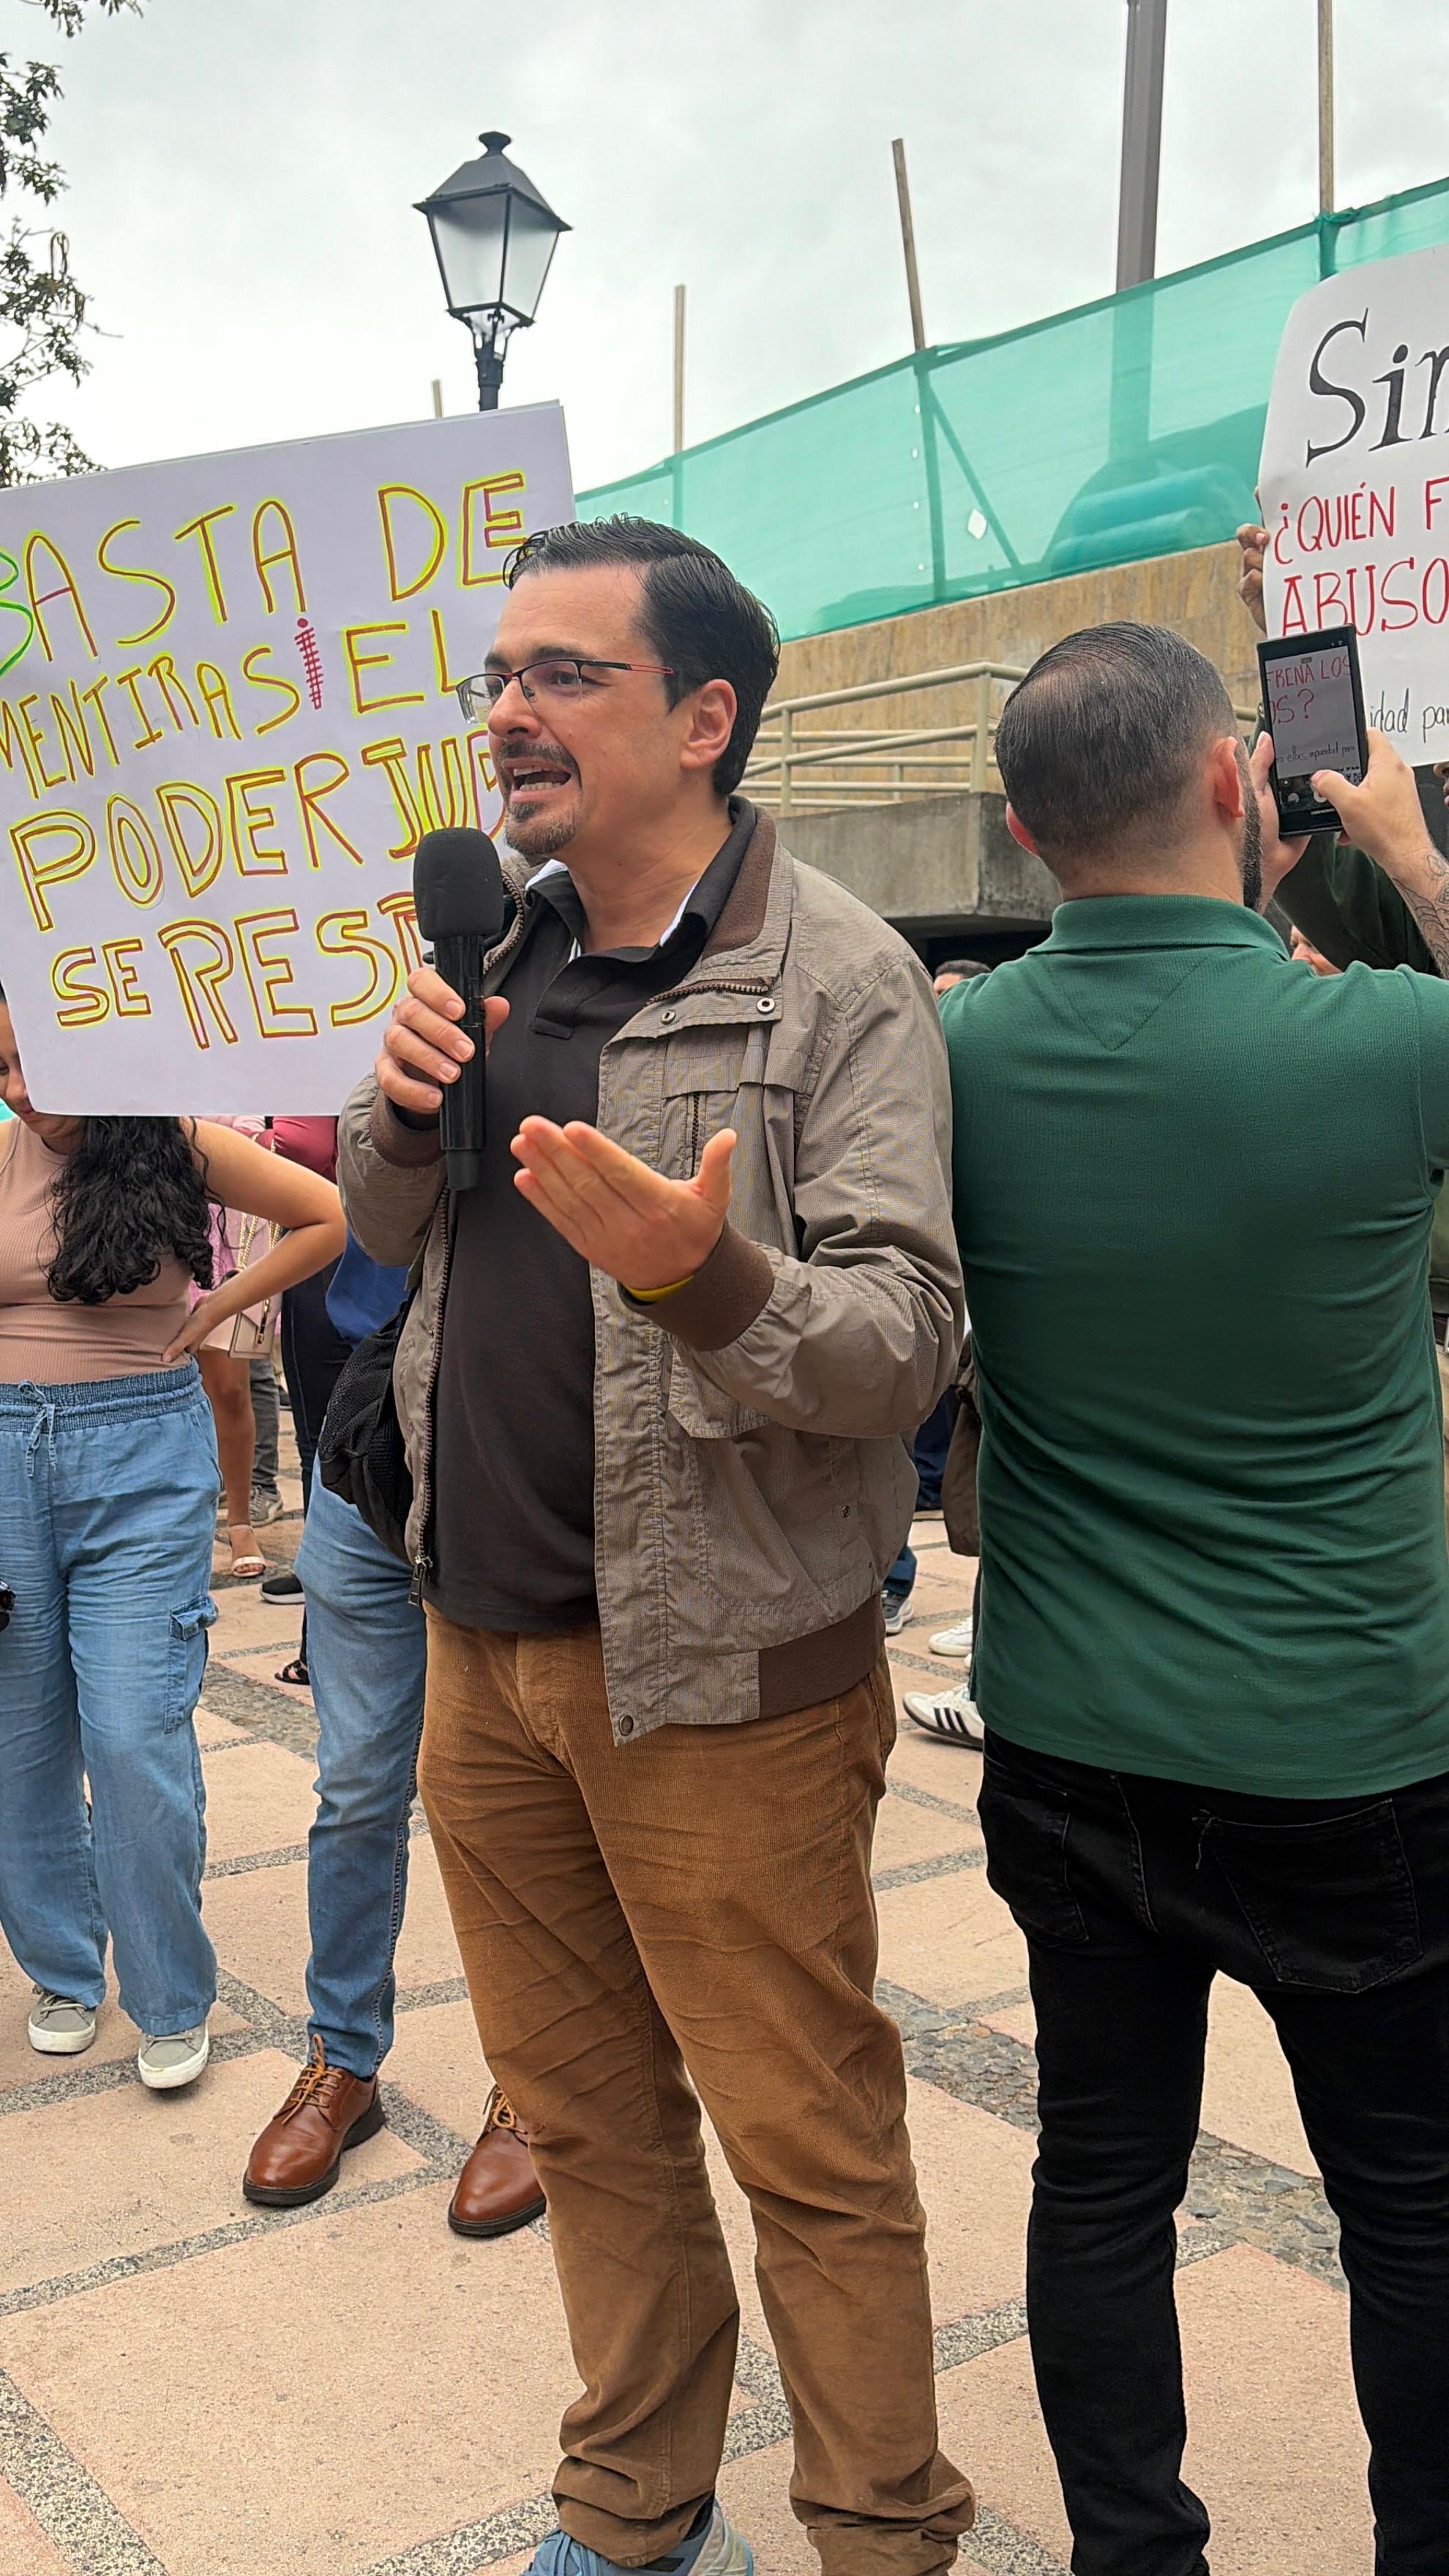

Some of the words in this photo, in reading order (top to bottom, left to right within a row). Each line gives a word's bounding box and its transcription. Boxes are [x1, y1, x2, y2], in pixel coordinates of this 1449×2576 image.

[378, 473, 525, 601] DE
[1274, 482, 1395, 564] ¿QUIÉN
[1283, 557, 1449, 637] ABUSO
[346, 610, 461, 713] EL
[1423, 705, 1449, 744] pa
[10, 752, 363, 931] PODER
[53, 939, 151, 1025] SE
